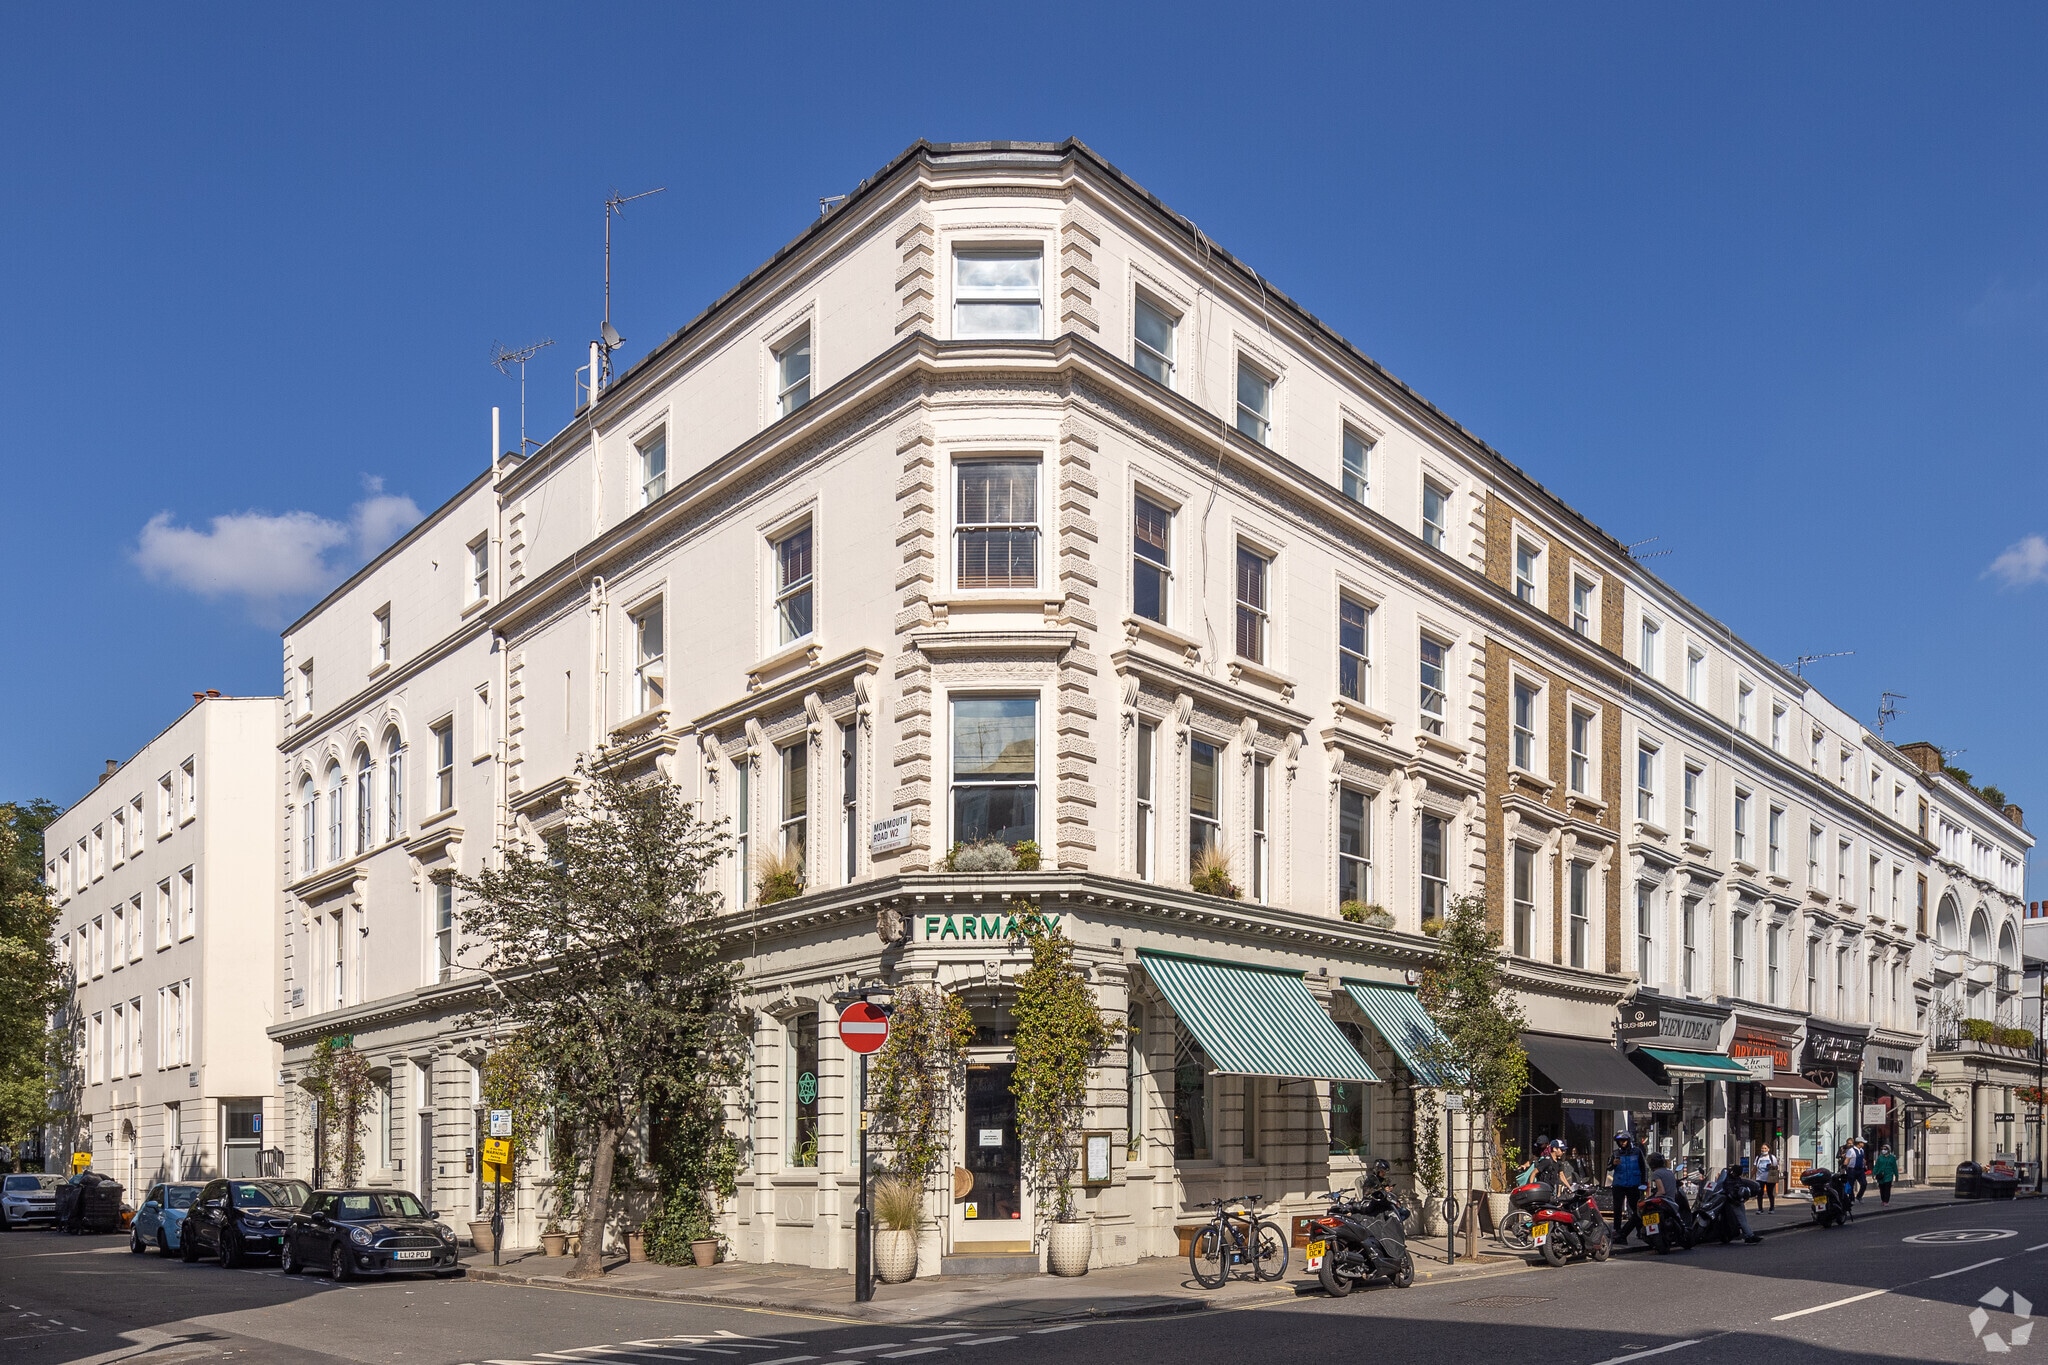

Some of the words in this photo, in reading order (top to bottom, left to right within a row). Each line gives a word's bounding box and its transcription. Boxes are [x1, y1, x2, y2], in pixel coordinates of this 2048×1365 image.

[873, 816, 907, 832] MONMOUTH
[873, 831, 888, 843] ROAD
[890, 829, 899, 838] W2
[1623, 1021, 1657, 1029] SUSHISHOP
[1682, 1021, 1713, 1040] IDEAS
[1735, 1044, 1751, 1058] DRY
[1649, 1224, 1655, 1232] L
[1312, 1258, 1319, 1267] L
